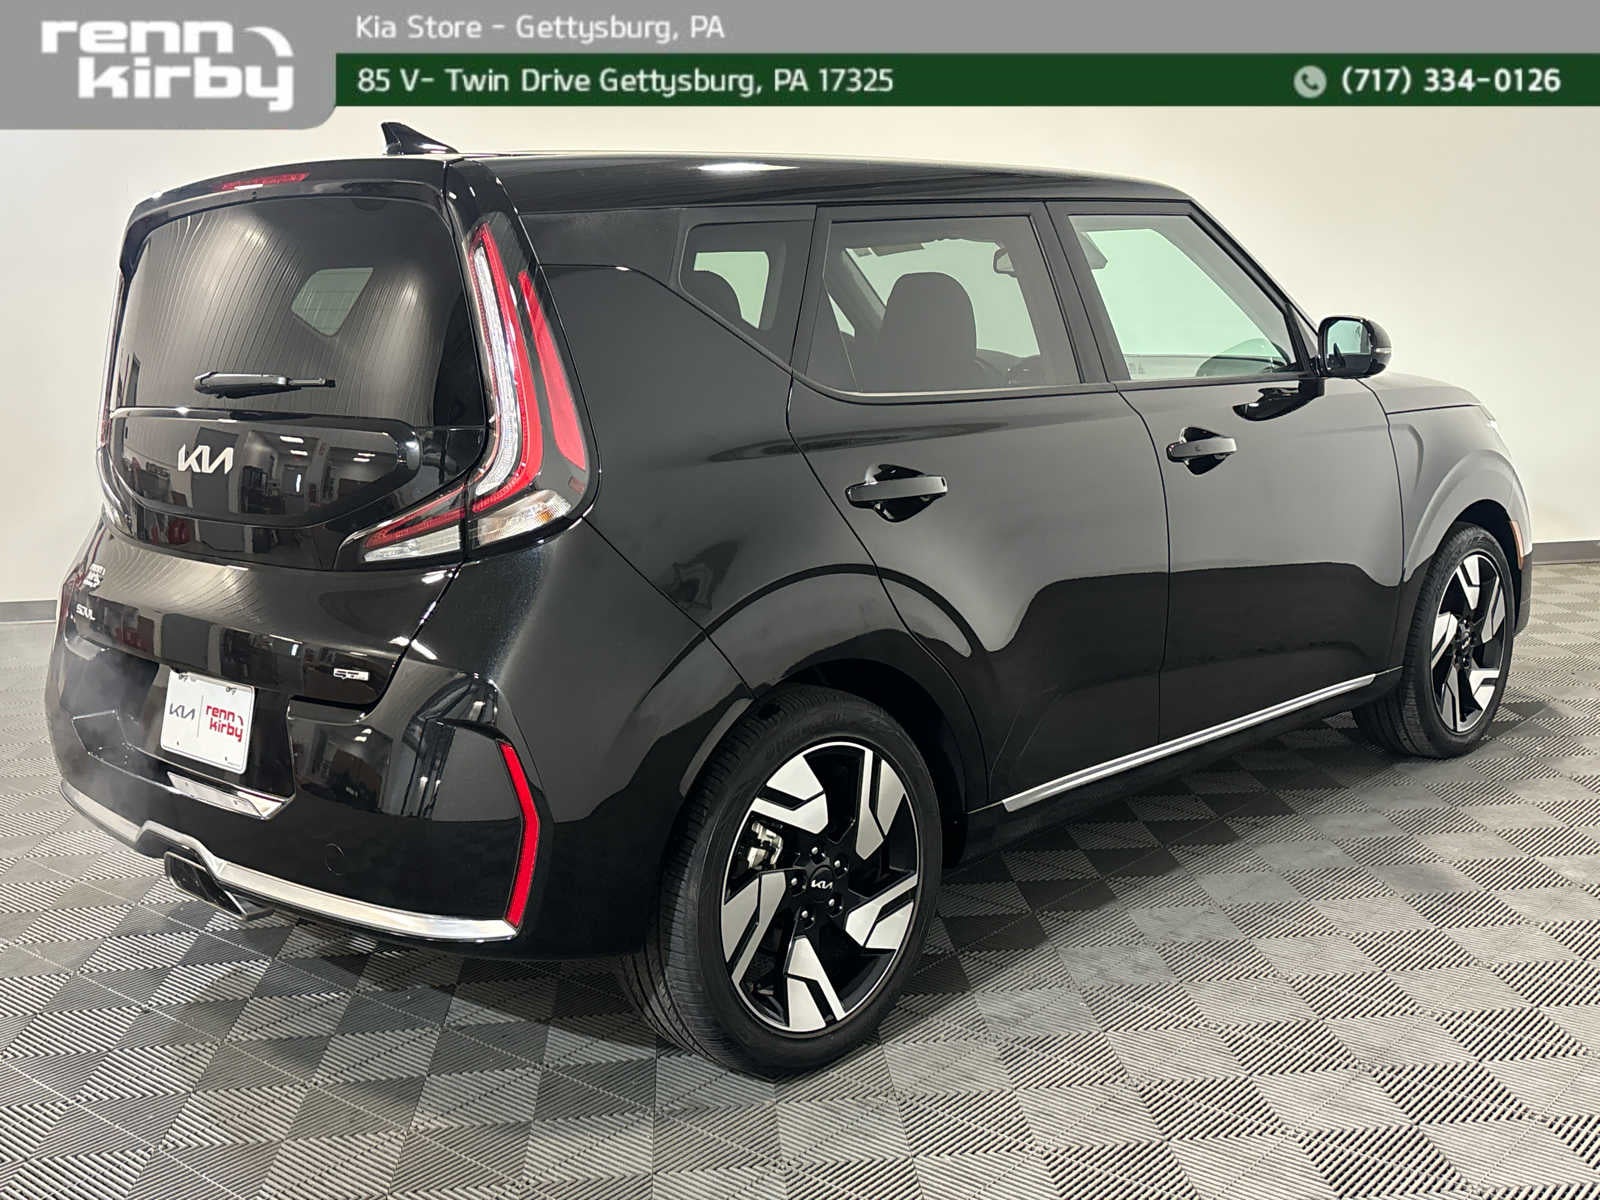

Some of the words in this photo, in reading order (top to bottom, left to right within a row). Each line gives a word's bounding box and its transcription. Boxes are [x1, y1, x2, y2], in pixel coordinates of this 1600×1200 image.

[177, 443, 234, 474] KIA
[206, 704, 236, 723] renn
[209, 717, 244, 743] kirby
